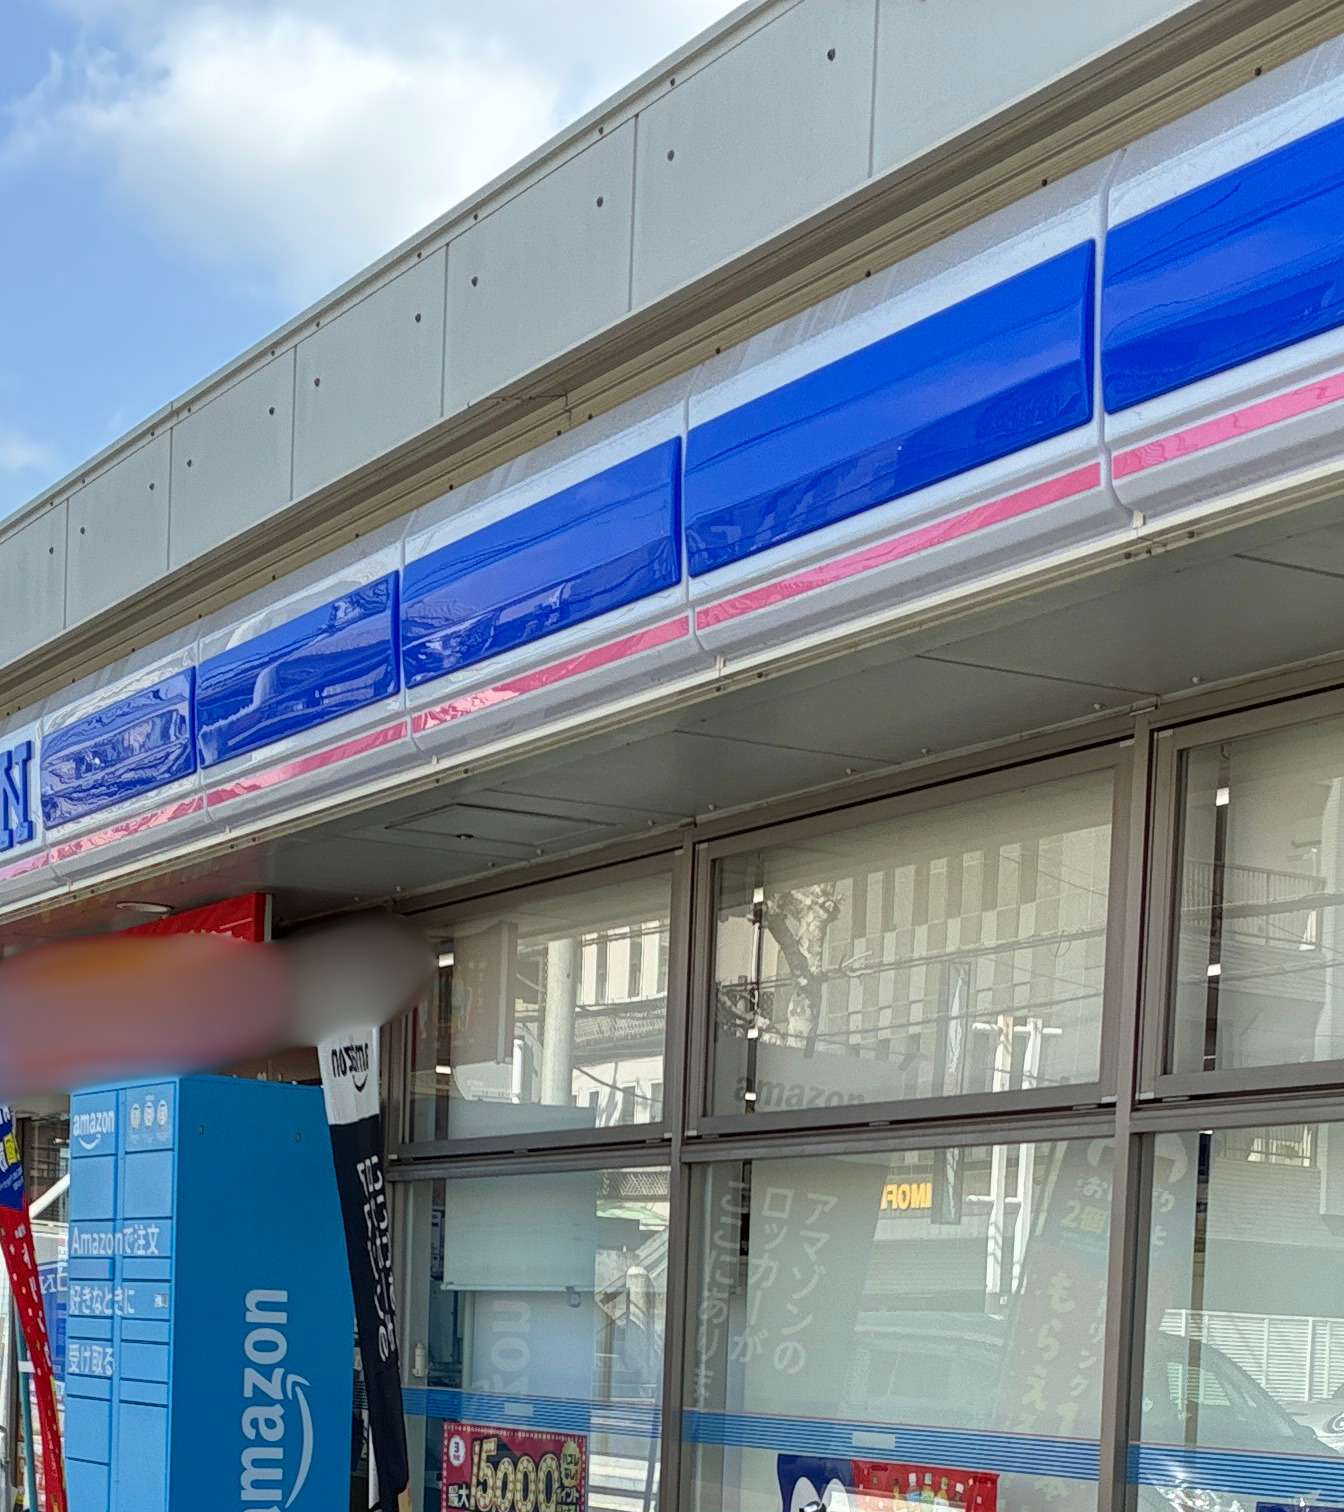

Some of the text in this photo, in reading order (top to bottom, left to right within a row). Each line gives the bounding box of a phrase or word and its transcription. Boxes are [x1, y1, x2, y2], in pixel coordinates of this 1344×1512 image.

[72, 1109, 115, 1138] amazon
[70, 1224, 160, 1257] Amazonで注文
[69, 1284, 136, 1316] 好きなときに
[67, 1342, 115, 1376] 受け取る
[448, 1484, 469, 1508] 最大
